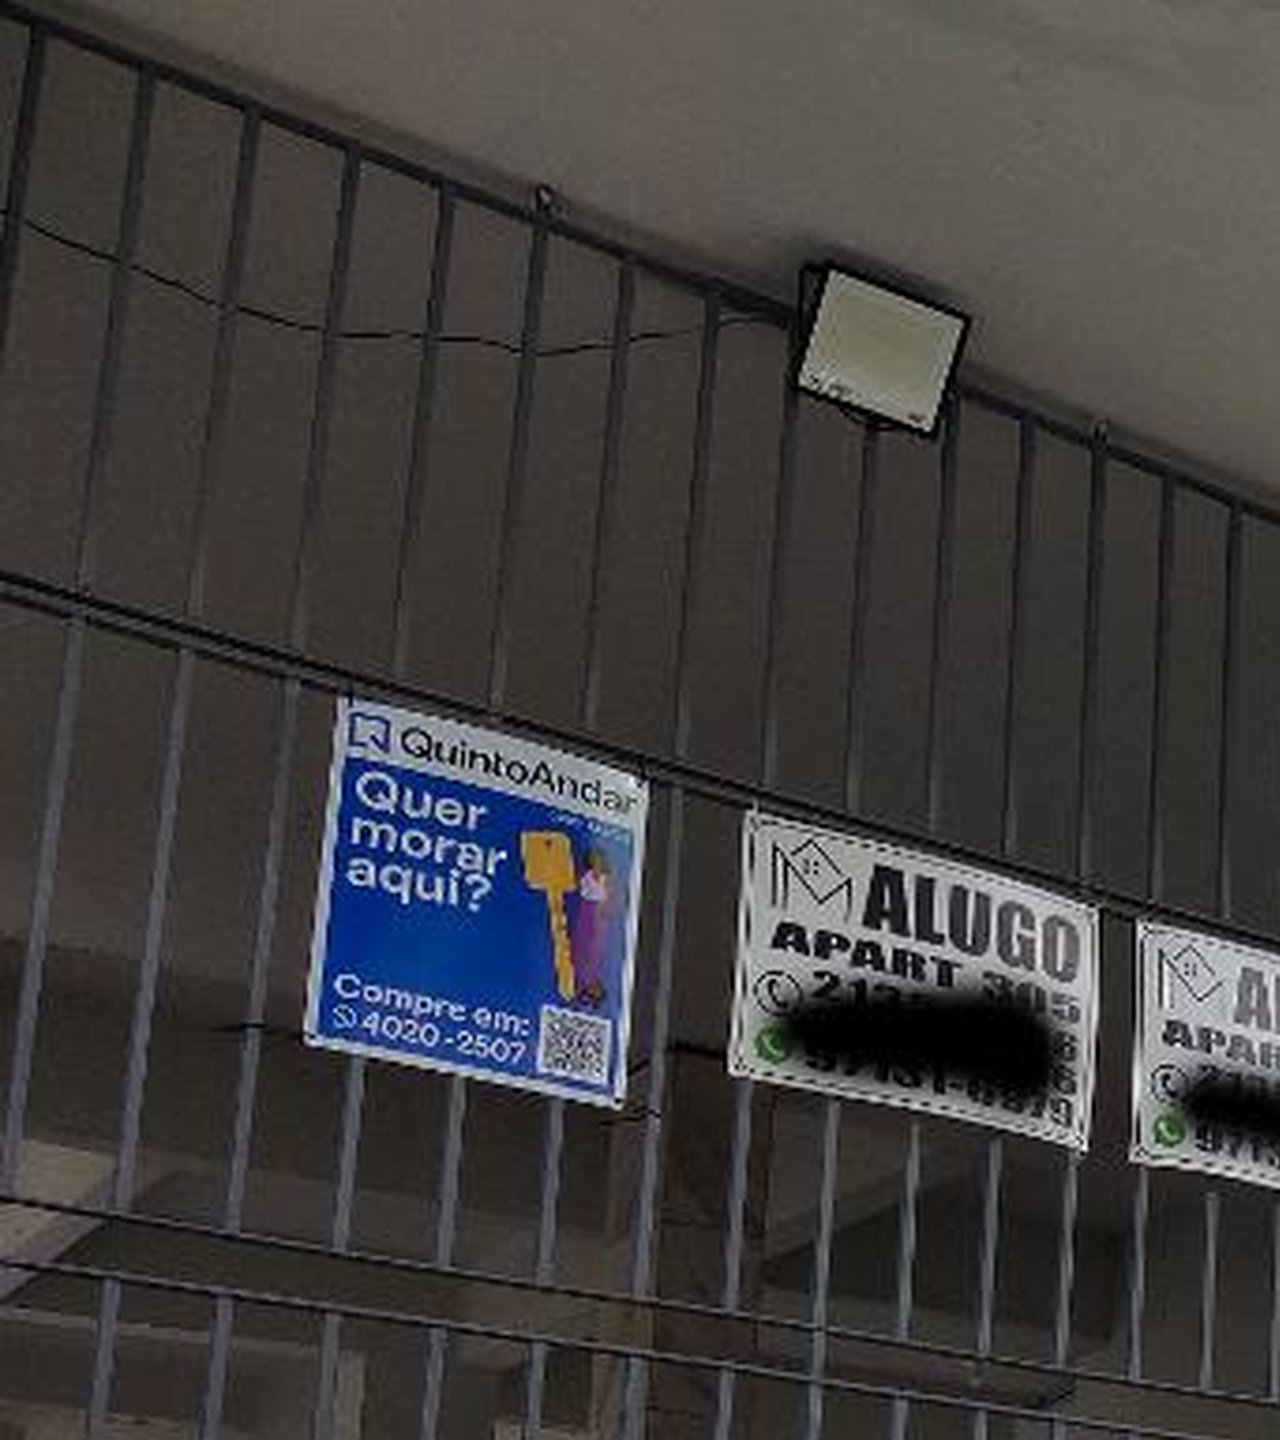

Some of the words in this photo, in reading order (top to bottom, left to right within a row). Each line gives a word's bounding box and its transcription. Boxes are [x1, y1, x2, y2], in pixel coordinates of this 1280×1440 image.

[354, 770, 489, 831] Quer
[400, 726, 637, 812] QuintoAndar
[351, 817, 508, 876] morar
[346, 857, 492, 912] aqui?
[770, 920, 962, 988] APART
[861, 863, 1081, 984] ALUGO
[333, 973, 466, 1023] Compre
[473, 1006, 530, 1037] em:
